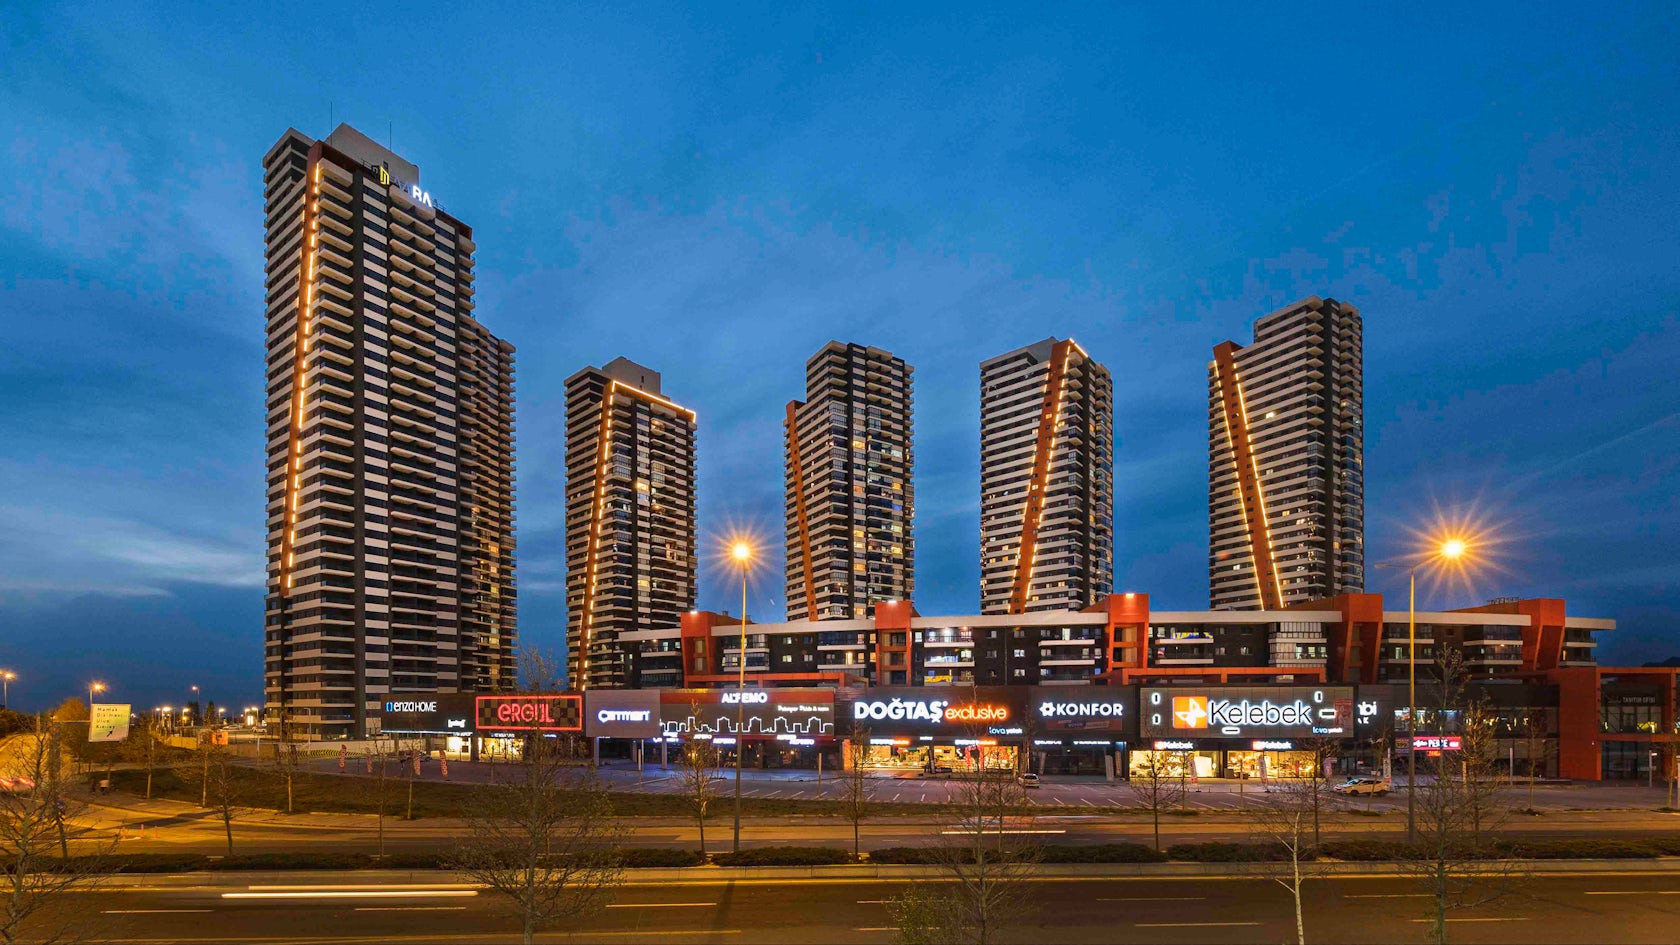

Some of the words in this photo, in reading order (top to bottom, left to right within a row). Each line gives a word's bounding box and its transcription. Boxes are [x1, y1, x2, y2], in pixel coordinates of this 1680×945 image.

[393, 702, 415, 712] enza
[415, 702, 437, 712] HOME
[854, 698, 942, 723] DOĞTAŞ
[944, 705, 1007, 720] exclusive
[1056, 703, 1123, 716] KONFOR
[1208, 701, 1313, 725] Kelebek
